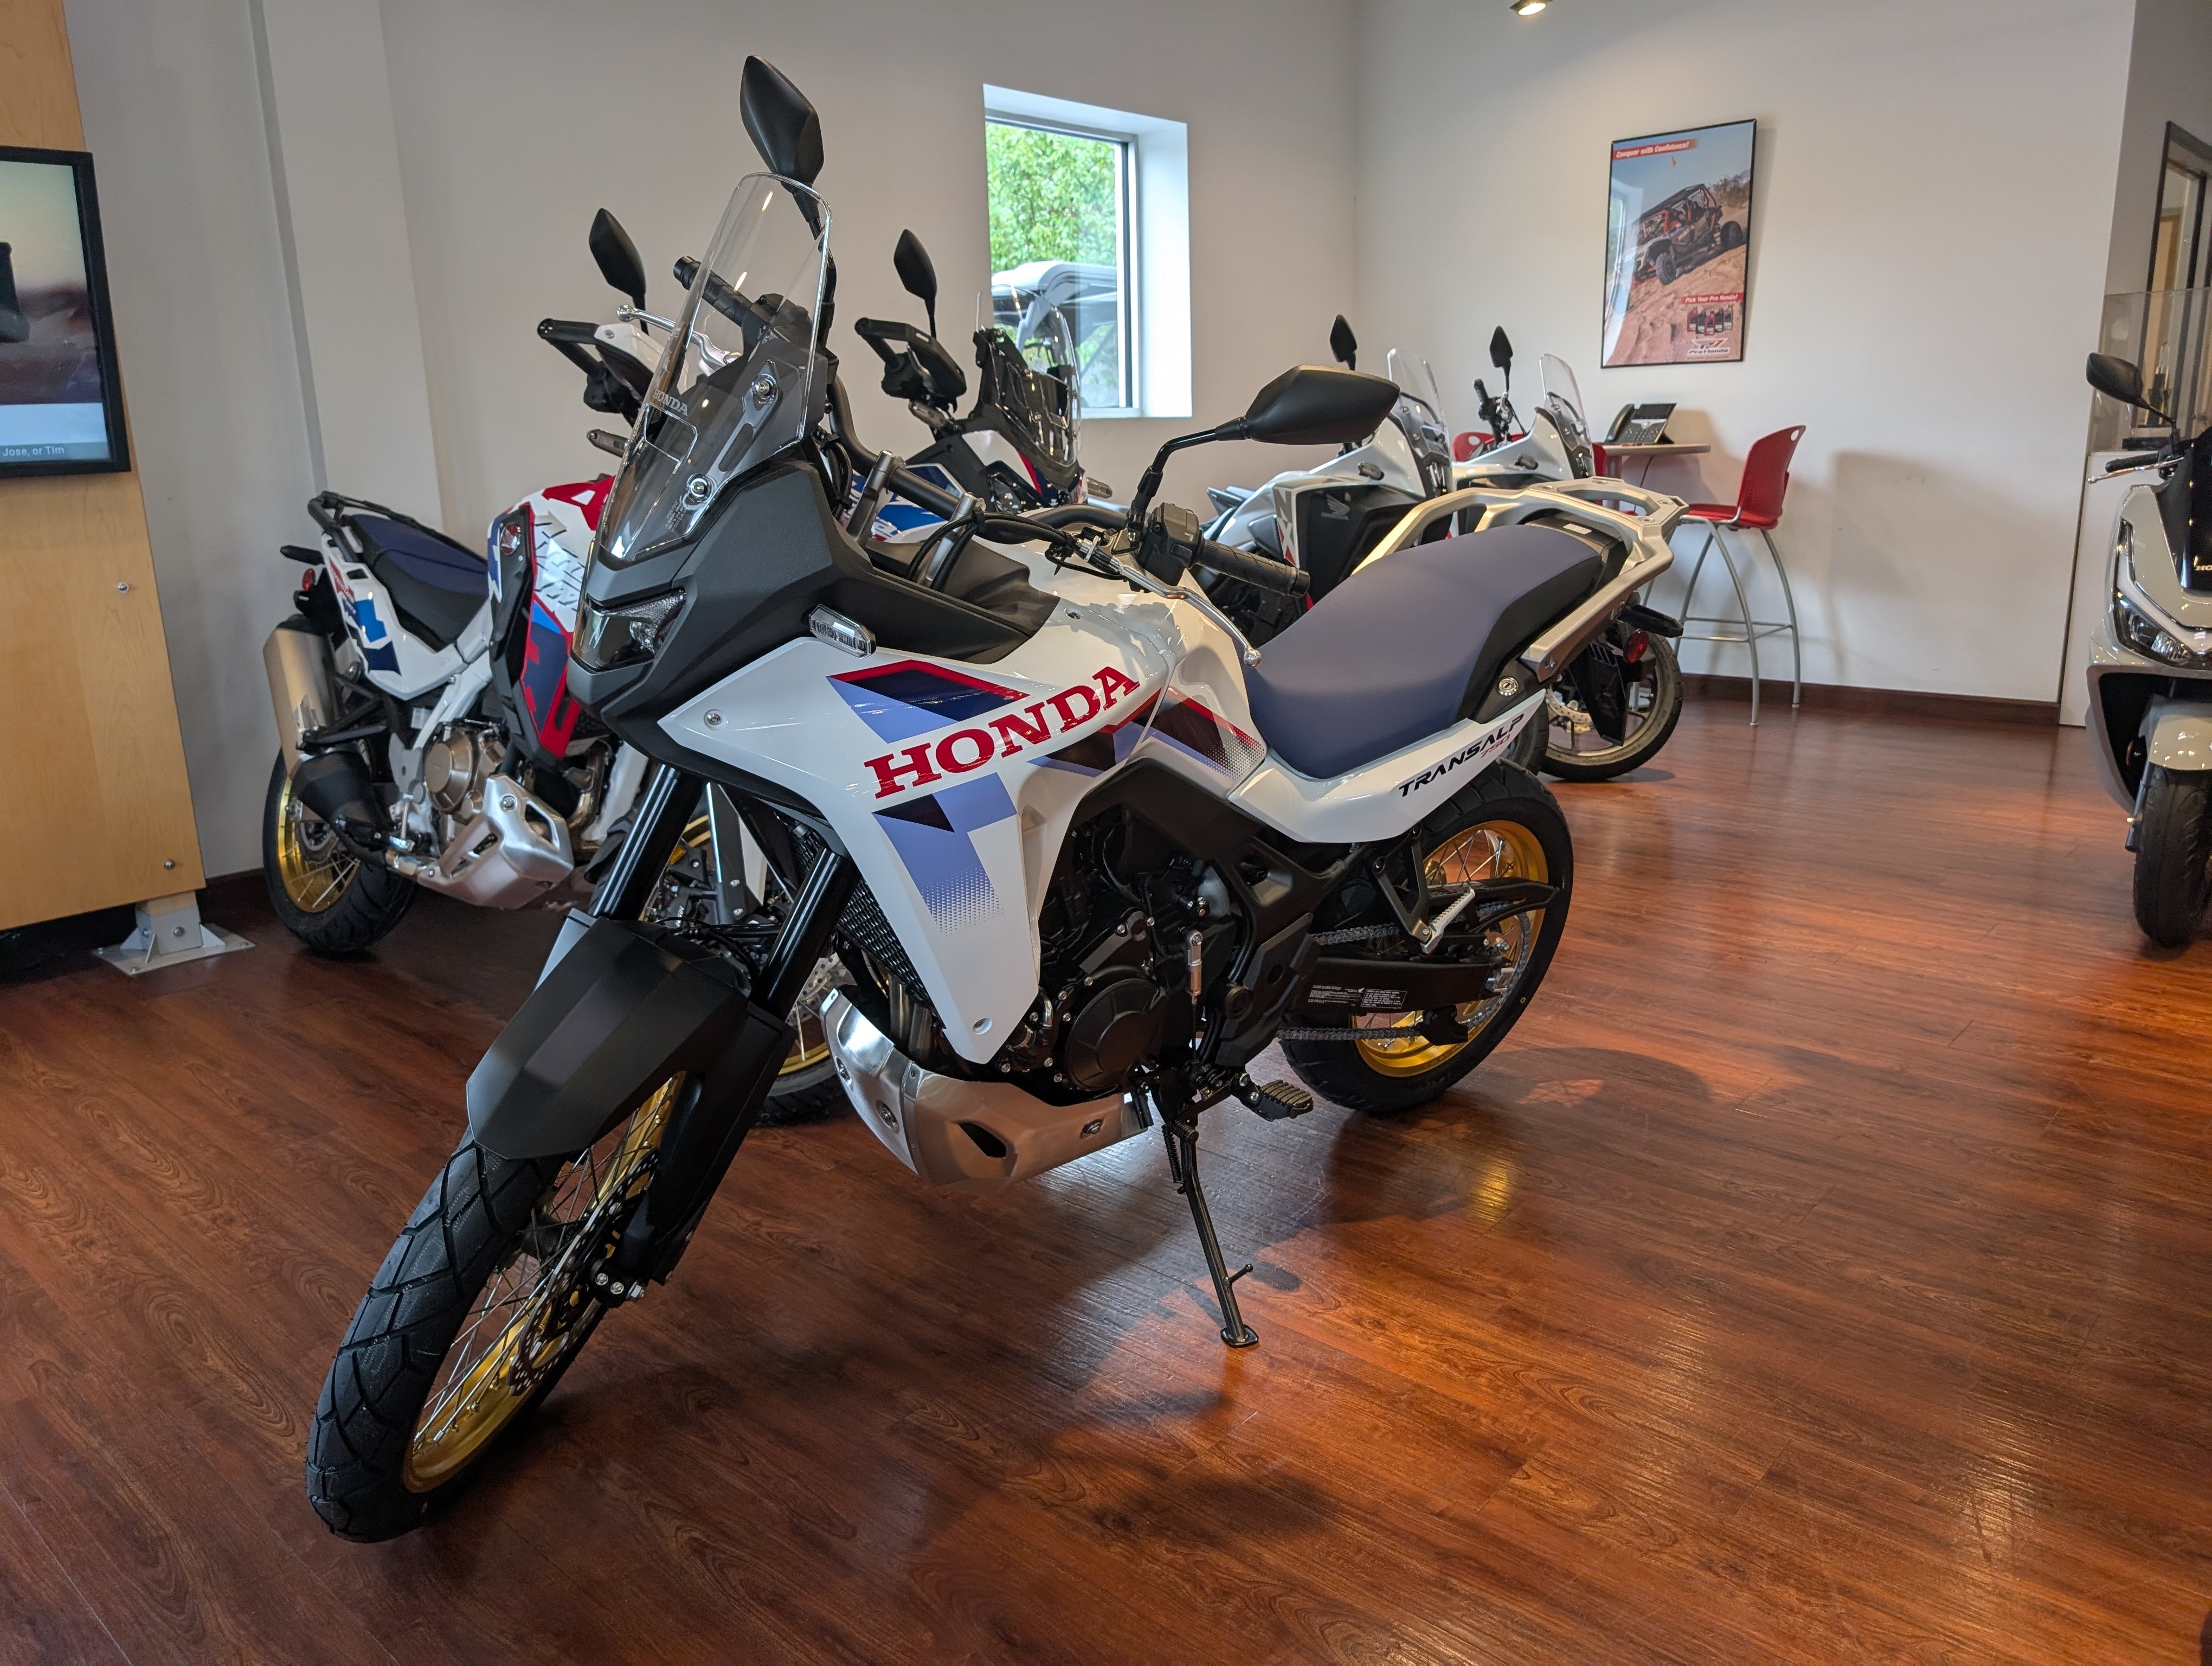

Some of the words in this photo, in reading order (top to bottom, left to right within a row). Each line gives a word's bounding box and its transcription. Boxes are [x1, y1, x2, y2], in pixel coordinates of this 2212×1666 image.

[1640, 146, 1654, 155] with
[653, 387, 688, 416] HONDA
[3, 447, 30, 457] Jose,
[44, 445, 65, 454] Tim
[864, 666, 1141, 799] HONDA
[1399, 713, 1524, 798] TRANSALP
[1480, 734, 1511, 759] 750
